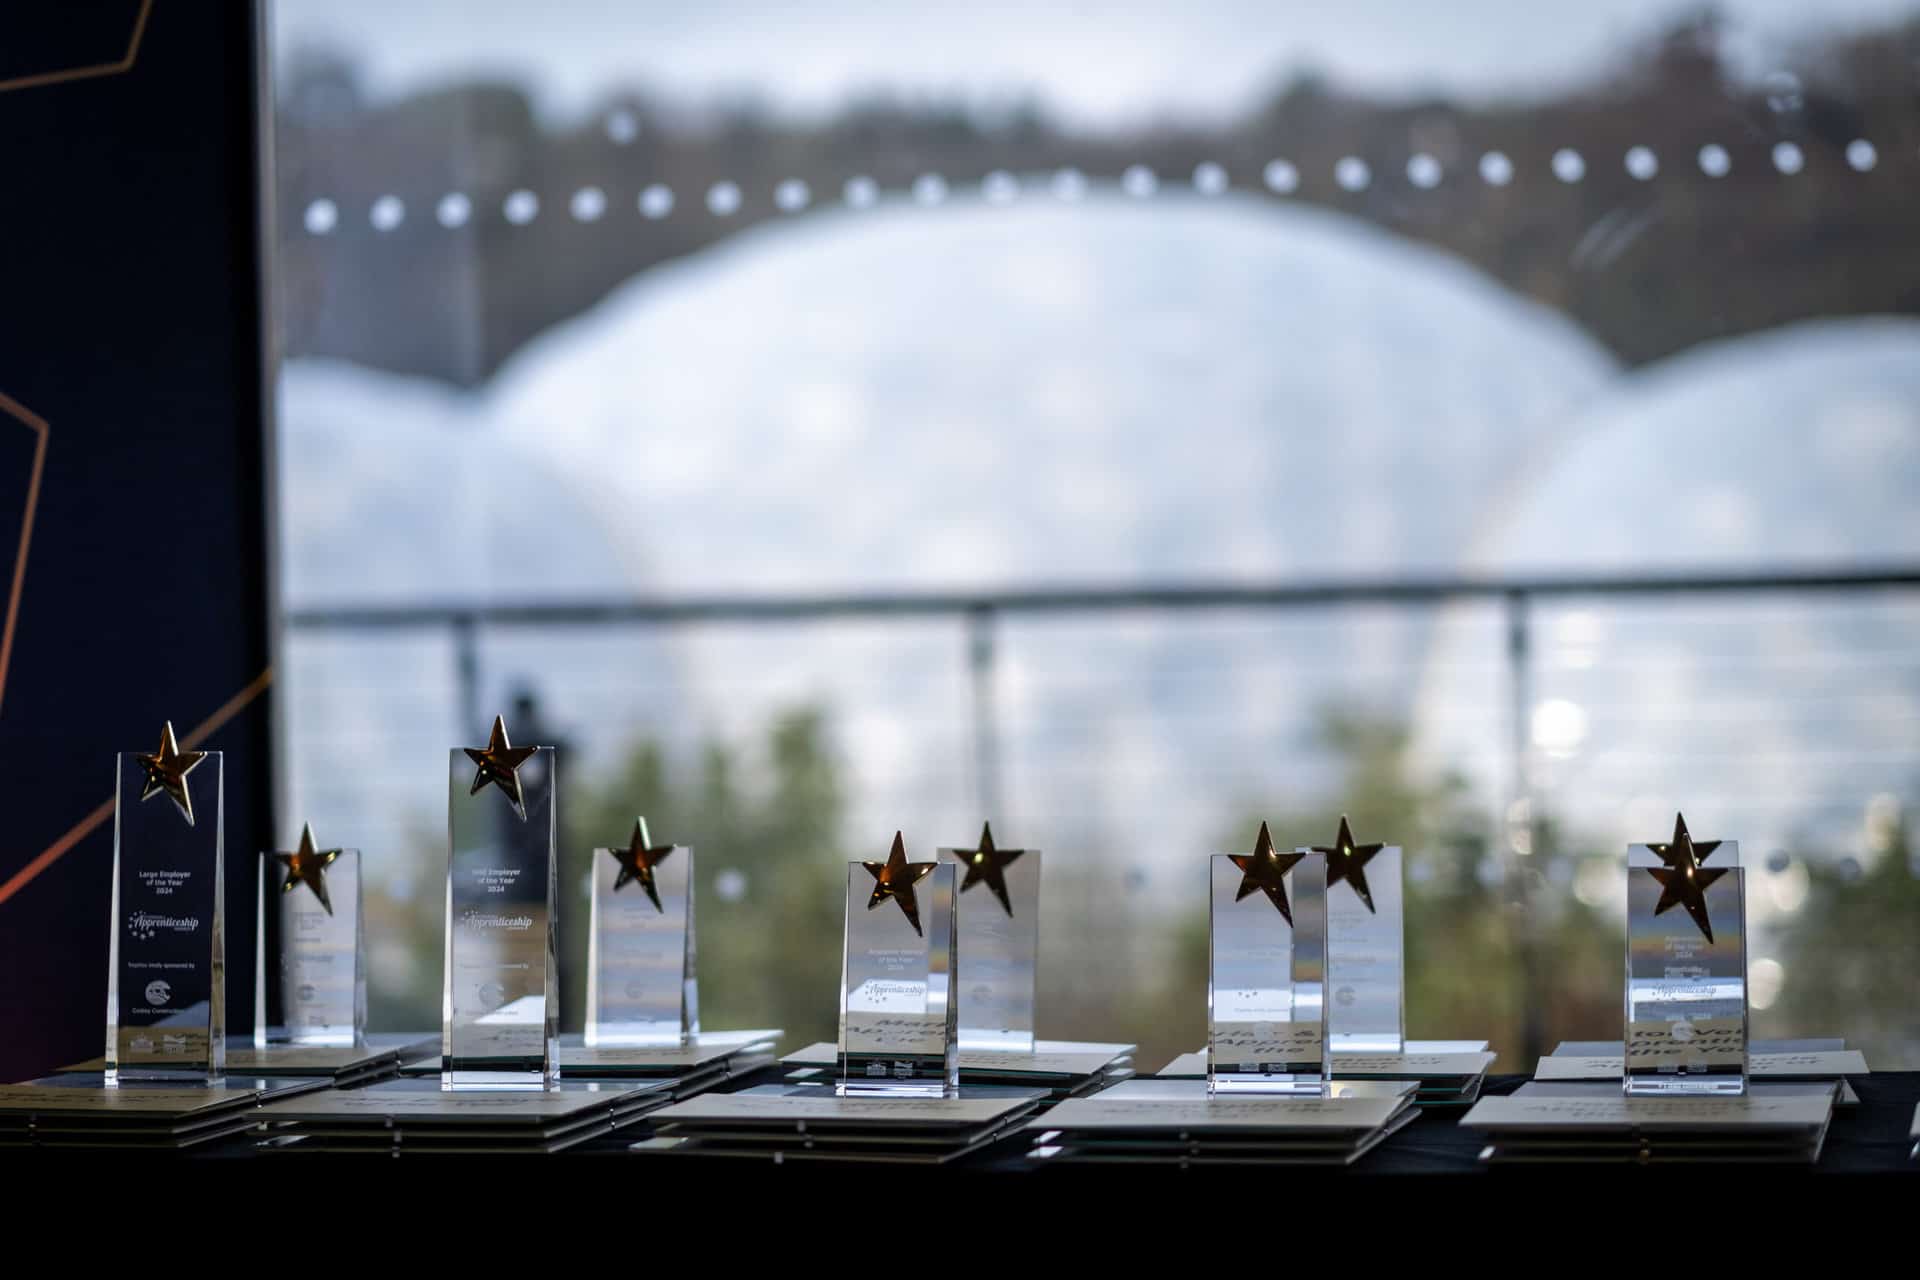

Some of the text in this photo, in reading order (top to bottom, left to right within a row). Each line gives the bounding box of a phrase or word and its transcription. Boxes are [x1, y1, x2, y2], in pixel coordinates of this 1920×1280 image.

[139, 871, 191, 880] Large Employer
[488, 869, 521, 877] Employer
[146, 879, 154, 887] of
[155, 879, 167, 887] the
[156, 887, 173, 895] 2024
[134, 915, 199, 932] Apprenticeship
[465, 914, 533, 931] Apprenticeship
